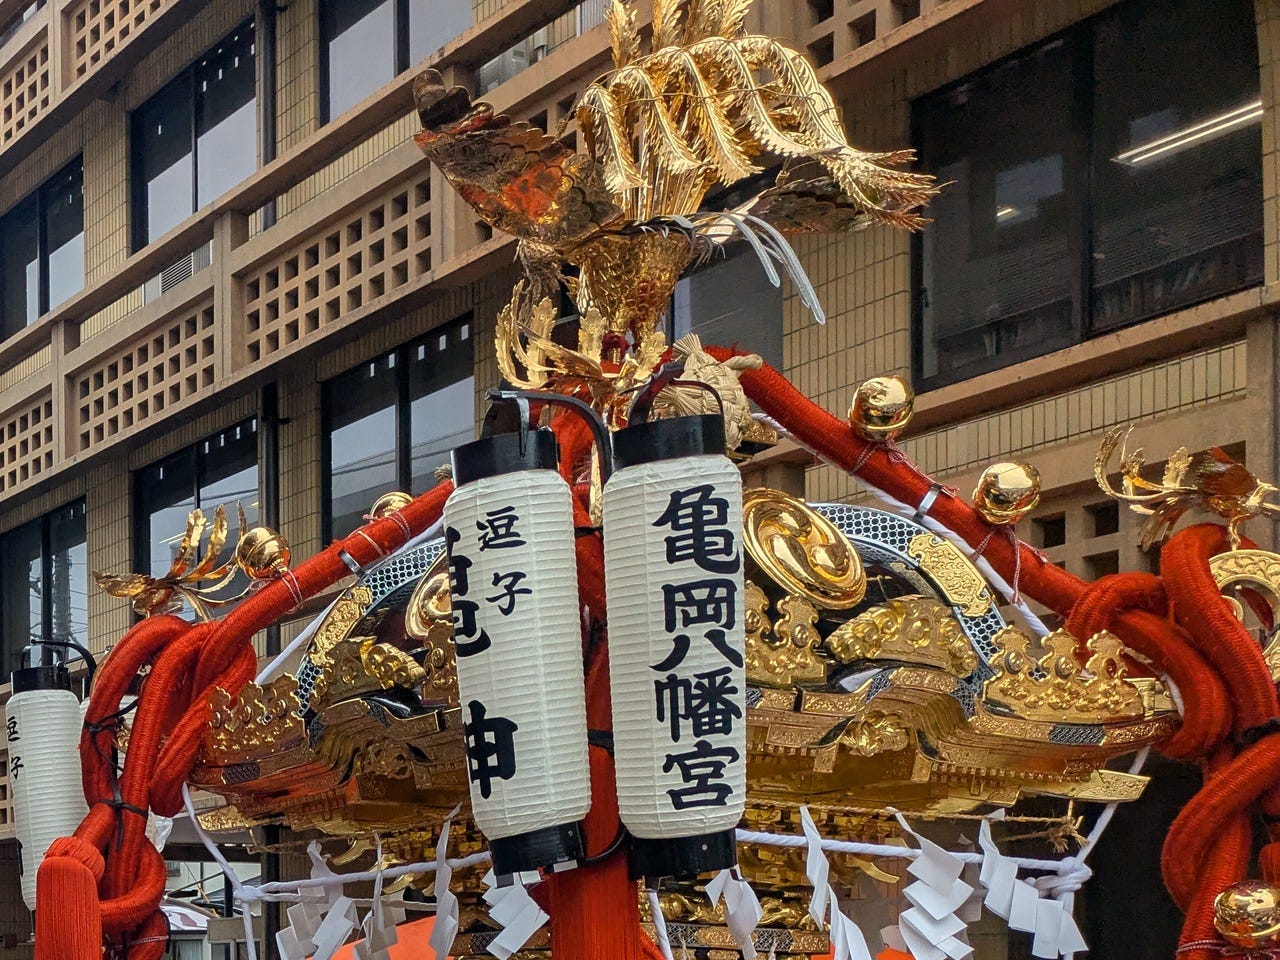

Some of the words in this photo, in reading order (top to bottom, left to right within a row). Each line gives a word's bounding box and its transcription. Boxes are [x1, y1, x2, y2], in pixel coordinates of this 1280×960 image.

[476, 505, 533, 616] 逗子
[649, 483, 744, 811] 亀岡八幡宮
